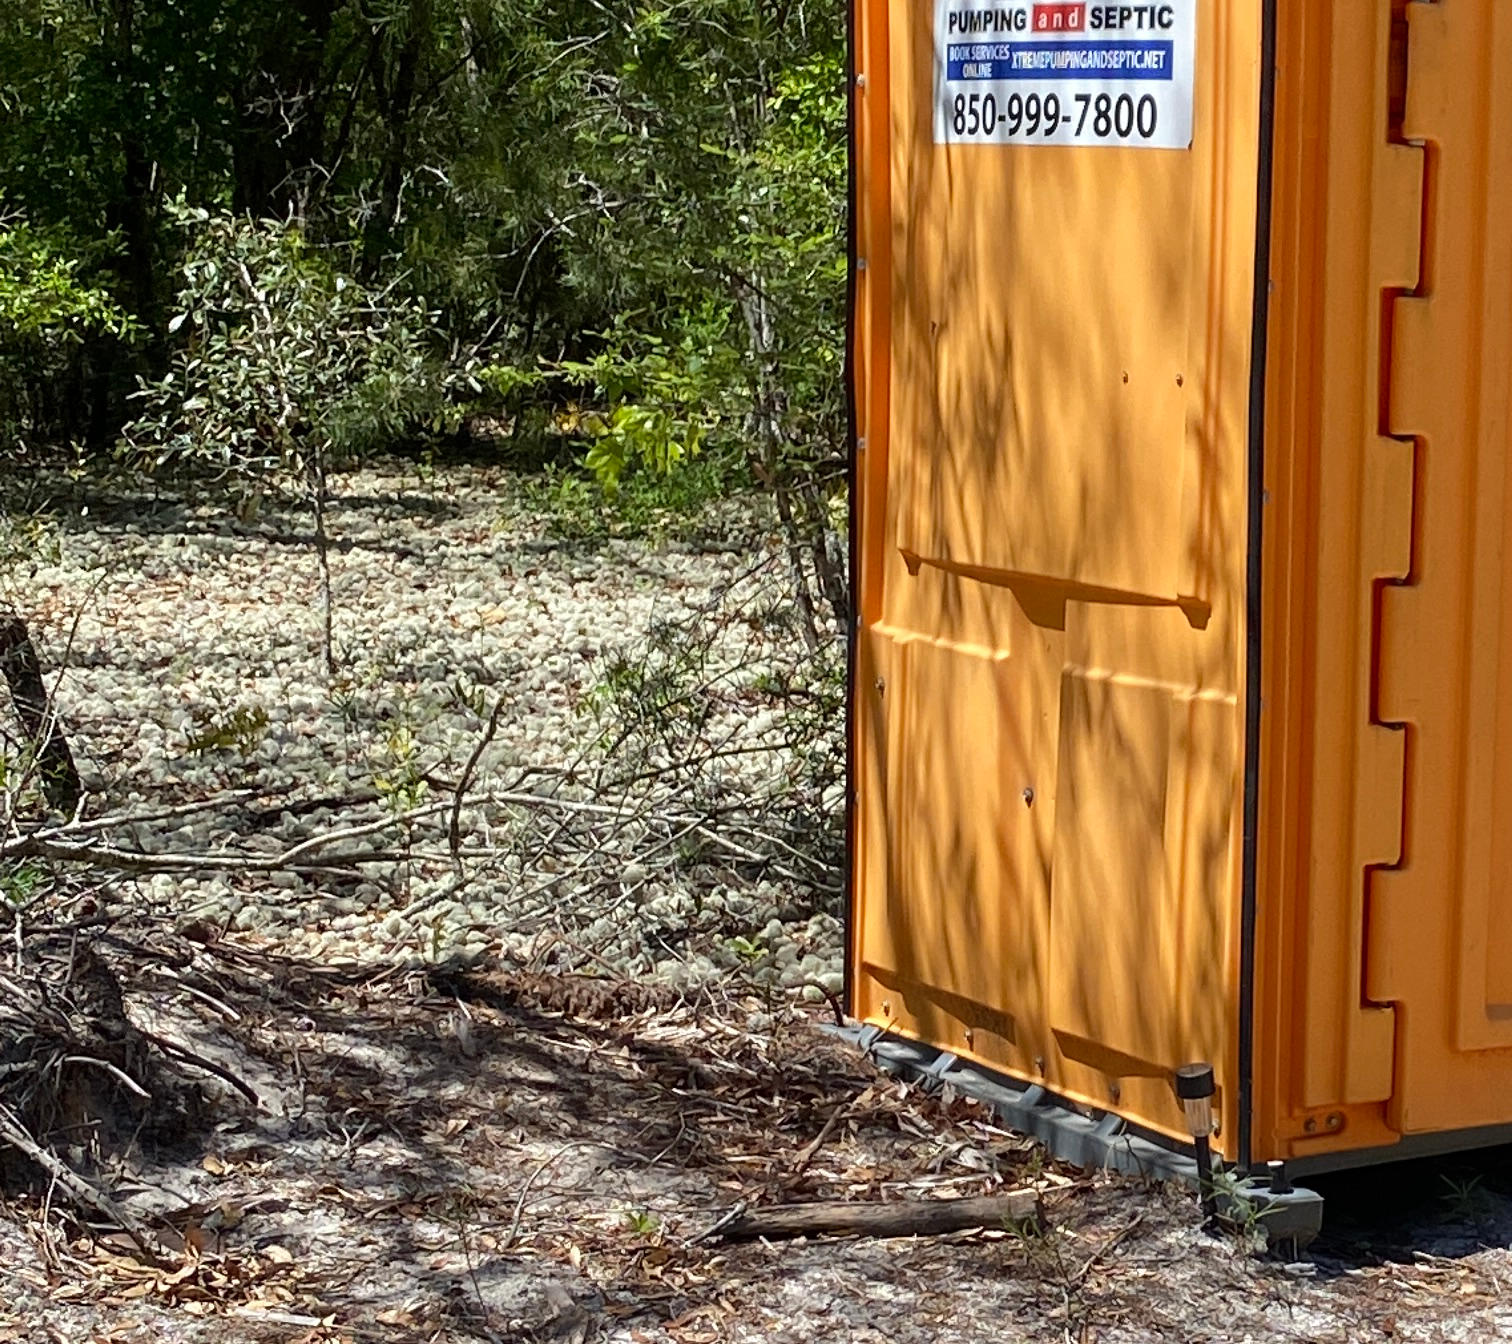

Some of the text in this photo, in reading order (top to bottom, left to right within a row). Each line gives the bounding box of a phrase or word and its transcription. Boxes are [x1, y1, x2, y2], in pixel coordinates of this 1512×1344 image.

[949, 5, 1174, 33] PUMPING and SEPTIC
[950, 44, 1010, 61] BOOK SERVICES
[1011, 49, 1166, 69] XTREMEPUMPINGANDSEPTIC.NET
[962, 62, 993, 78] ONLINE
[953, 92, 1158, 138] 850-999-7800
